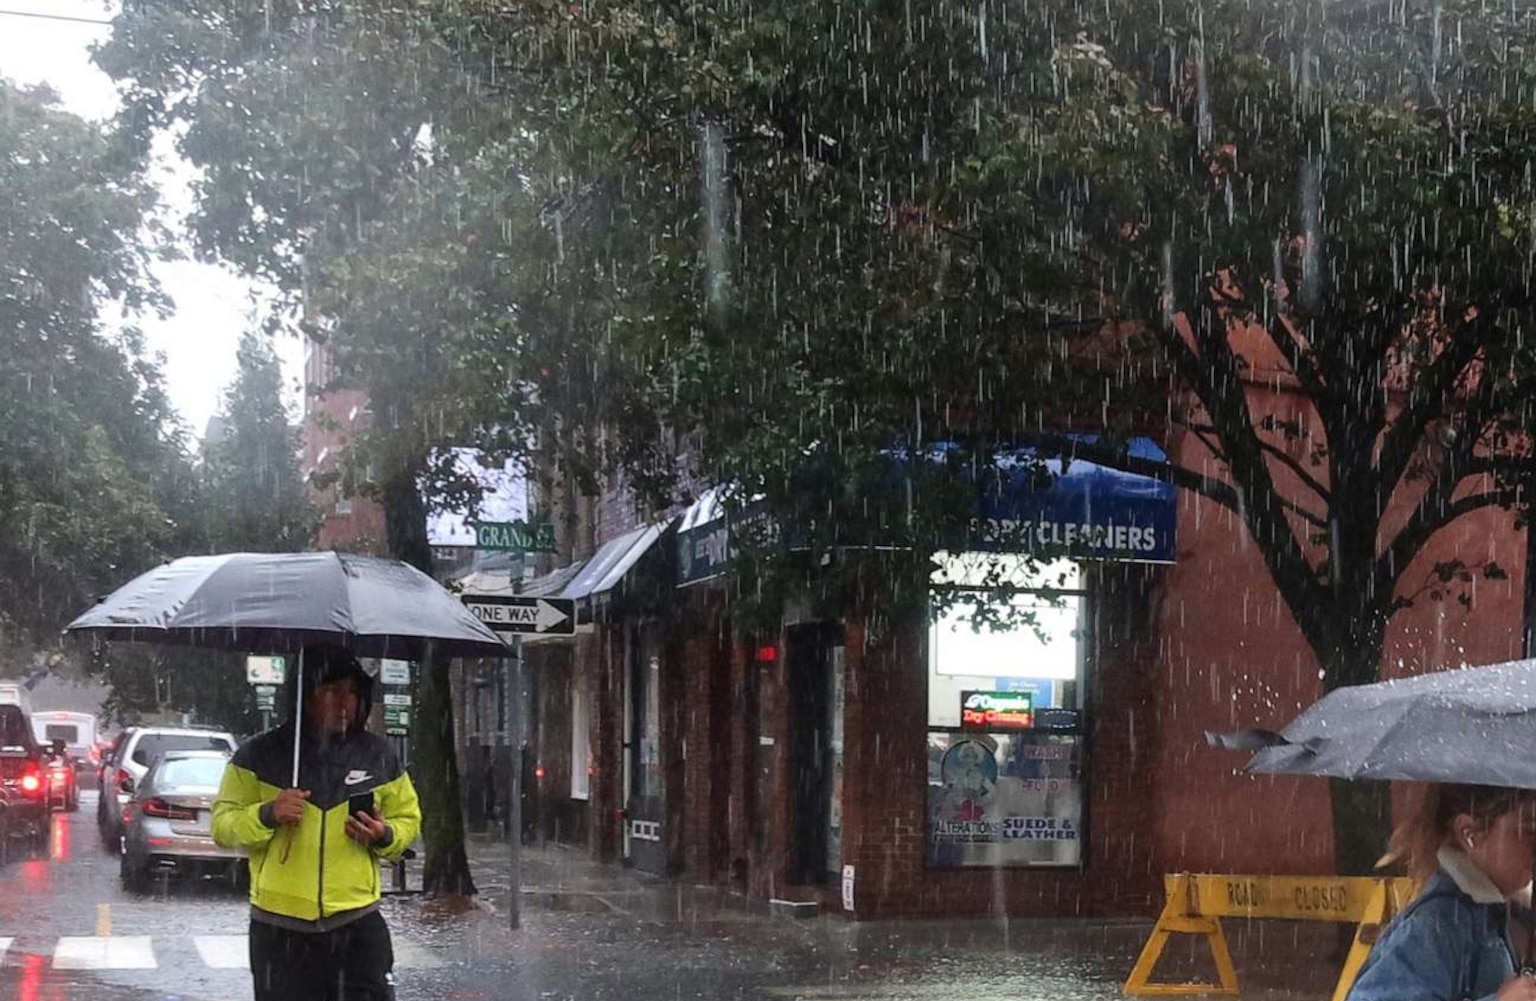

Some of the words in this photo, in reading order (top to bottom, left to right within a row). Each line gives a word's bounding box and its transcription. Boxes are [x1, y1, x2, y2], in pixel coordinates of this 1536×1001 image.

[480, 525, 533, 548] GRAND
[470, 606, 503, 620] ONE
[508, 608, 540, 622] WAY
[1003, 818, 1056, 829] SUEDE
[1062, 818, 1072, 829] &
[1003, 830, 1076, 840] LEATHER
[1227, 882, 1258, 907] ROAD
[1295, 886, 1347, 911] CLOSED
